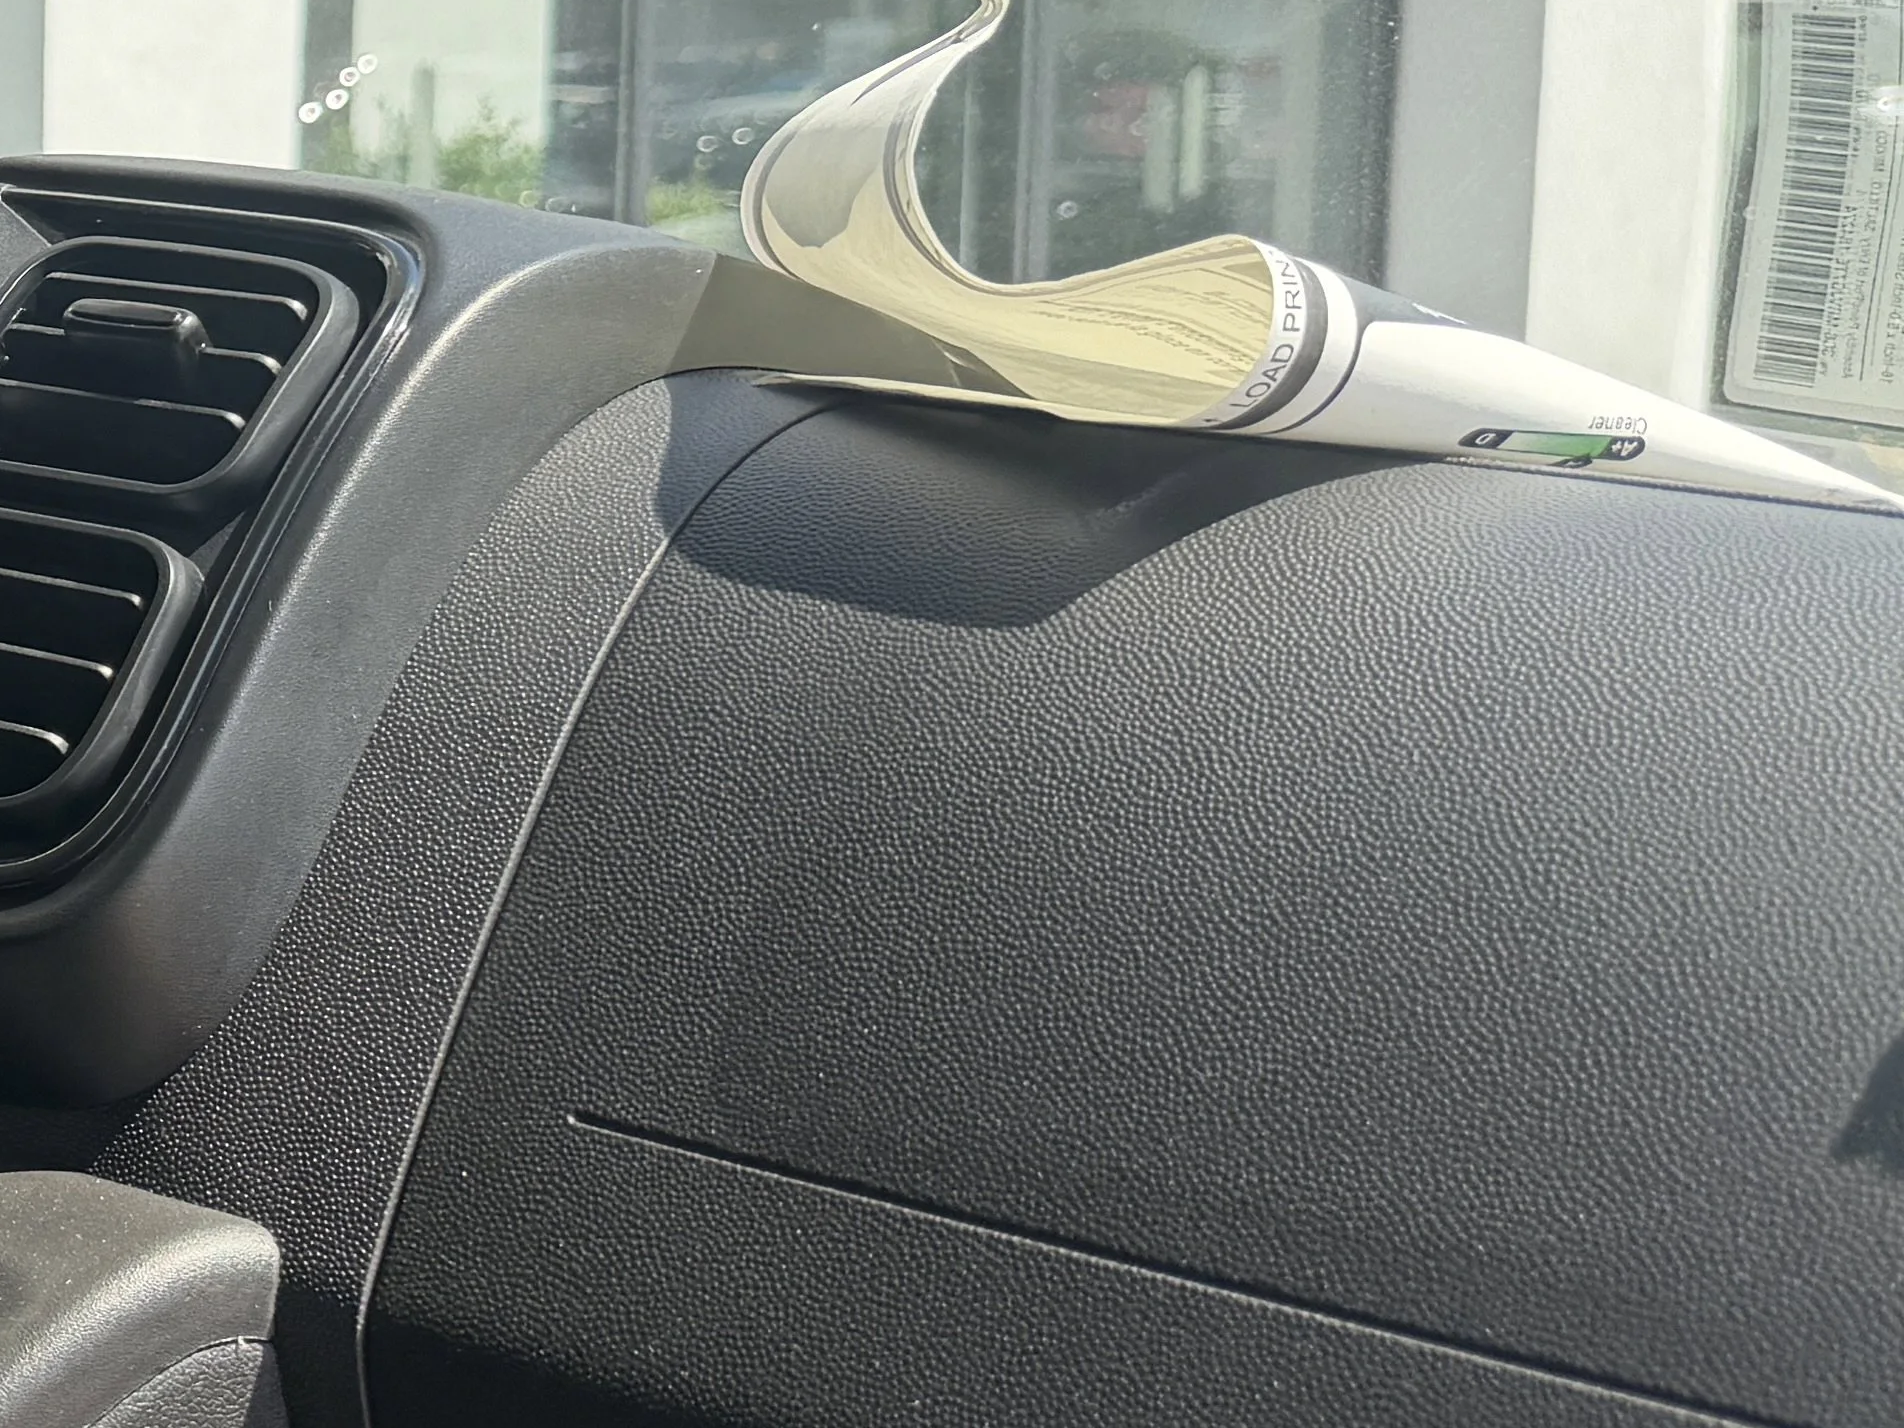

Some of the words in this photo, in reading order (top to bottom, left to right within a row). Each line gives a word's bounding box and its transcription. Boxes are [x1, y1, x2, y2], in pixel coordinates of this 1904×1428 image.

[1229, 343, 1294, 408] LOAD
[1273, 254, 1302, 333] PRIN
[1588, 415, 1648, 435] Cleaner
